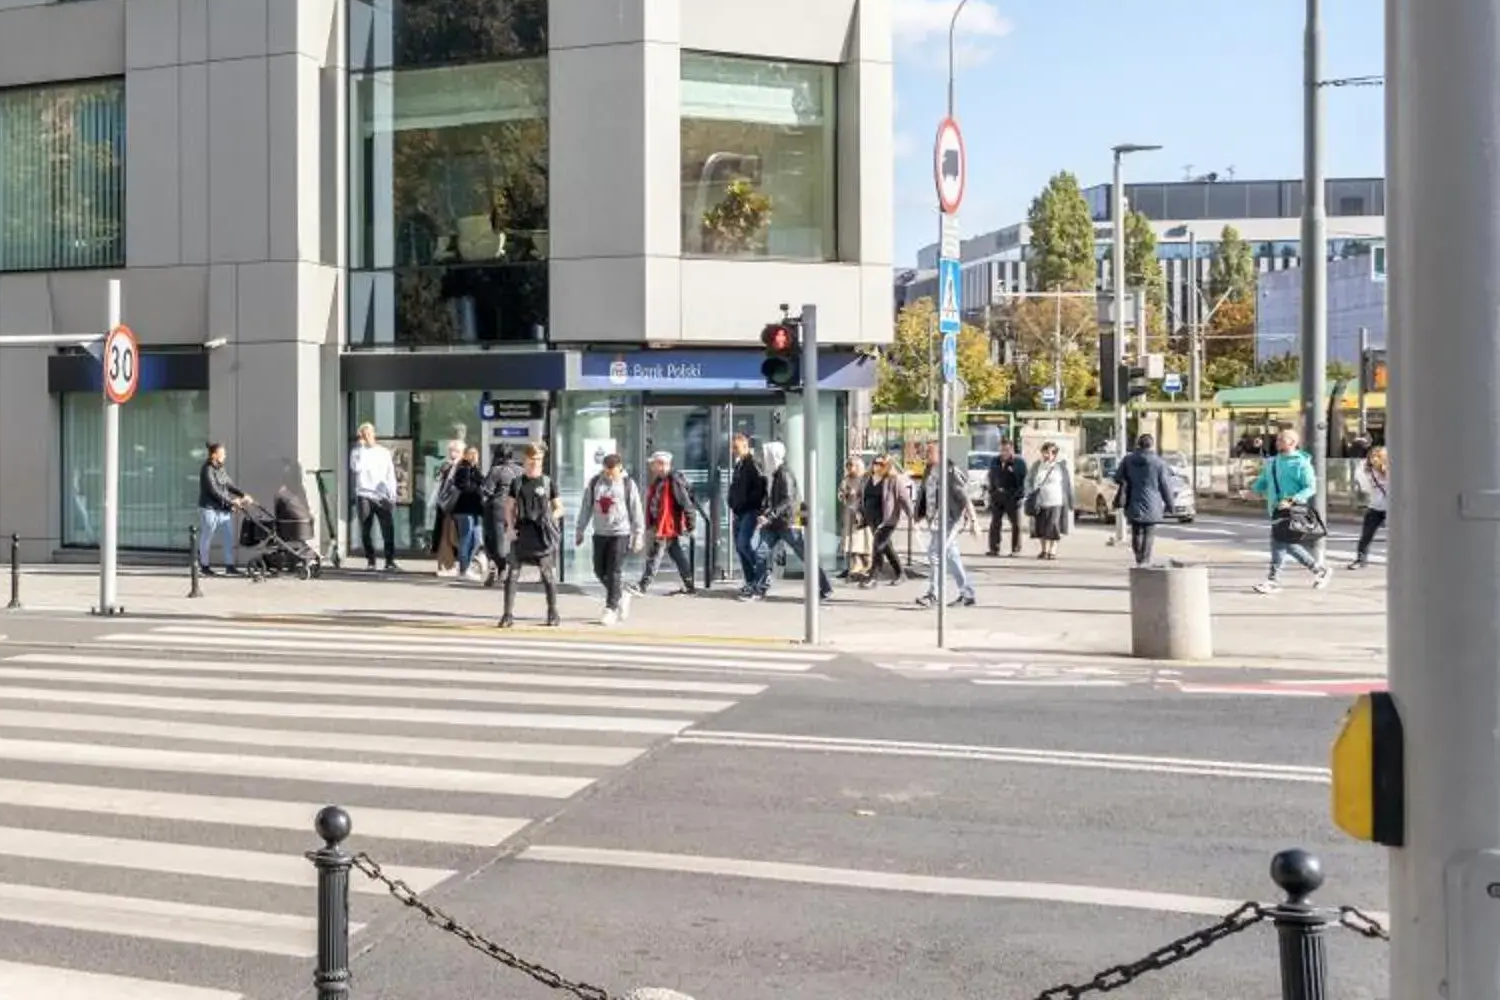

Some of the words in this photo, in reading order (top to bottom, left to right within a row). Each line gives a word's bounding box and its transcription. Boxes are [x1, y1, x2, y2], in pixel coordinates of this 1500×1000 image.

[109, 345, 133, 382] 30
[633, 363, 663, 380] Bank
[666, 362, 701, 378] Polski
